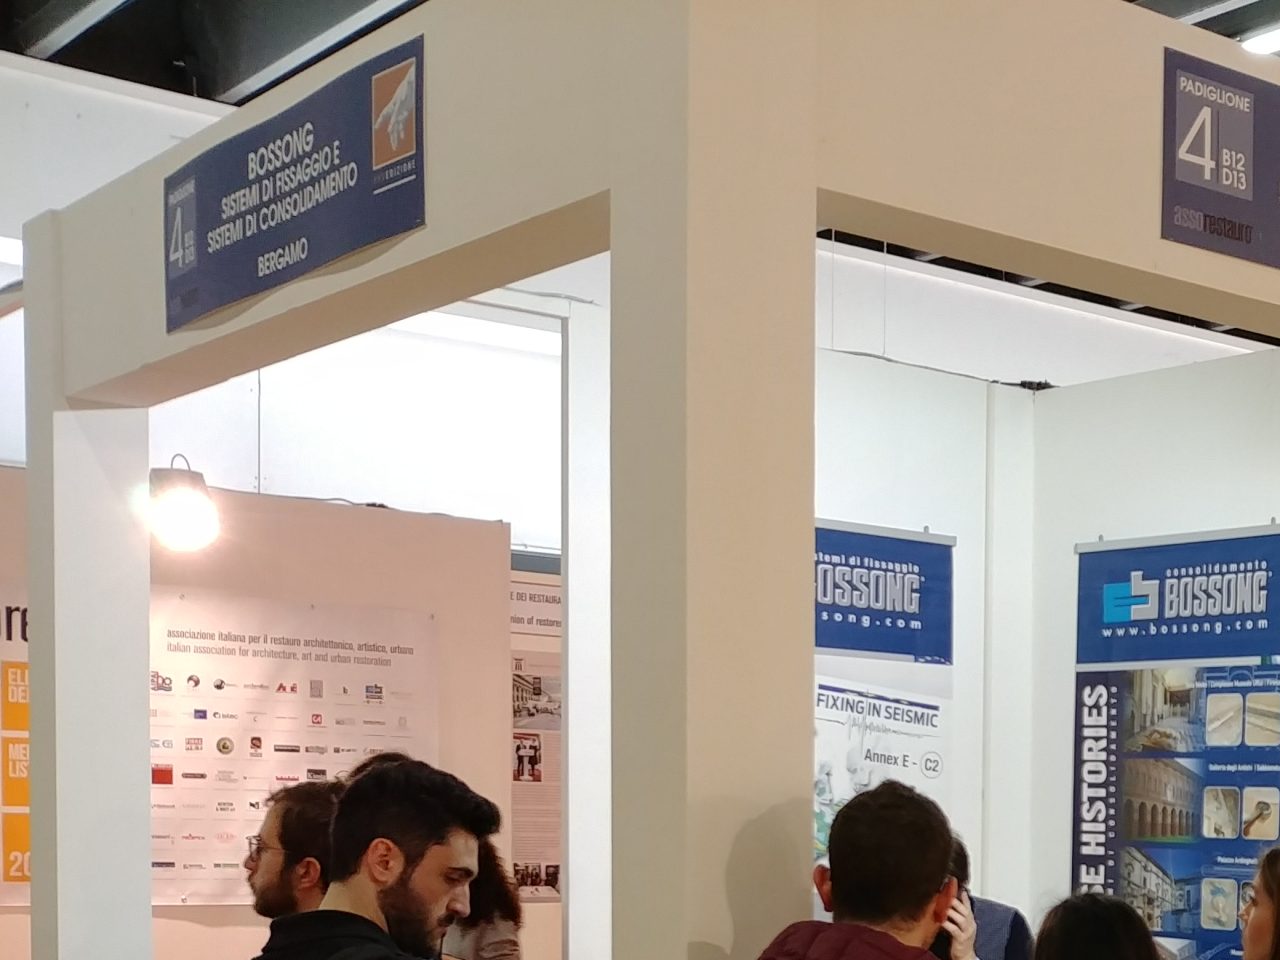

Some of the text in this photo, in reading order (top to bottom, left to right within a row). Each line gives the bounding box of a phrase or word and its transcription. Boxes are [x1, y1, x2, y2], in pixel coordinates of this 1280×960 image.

[1179, 76, 1251, 113] PADIGLIONE
[248, 121, 315, 181] BOSSONG
[1178, 105, 1216, 181] 4
[1221, 148, 1246, 171] B12
[221, 187, 259, 220] SISTEMI
[261, 181, 274, 202] DI
[275, 146, 332, 196] FISSAGGIO
[332, 139, 341, 165] E
[1222, 167, 1247, 191] D13
[207, 219, 244, 253] SISTEMI
[245, 214, 257, 235] DI
[259, 161, 358, 231] CONSOLIDAMENTO
[1174, 204, 1254, 245] assorestauro
[169, 206, 184, 268] 4
[257, 237, 309, 278] BERGAMO
[848, 555, 861, 566] di
[863, 557, 920, 574] fissaggio
[1165, 559, 1268, 578] consolidamento
[516, 591, 527, 602] DEI
[1164, 570, 1269, 619] BOSSONG
[166, 628, 216, 641] associazione
[217, 630, 247, 644] italiana
[247, 633, 261, 646] per
[263, 633, 269, 645] il
[270, 635, 301, 647] restauro
[389, 644, 414, 656] urbano
[1101, 618, 1269, 638] www.bossong.com
[166, 641, 392, 668] italian association for architecture, art and urban restoration
[816, 692, 939, 729] FIXING IN SEISMIC
[863, 748, 900, 767] Annex
[902, 754, 910, 768] E
[924, 757, 940, 773] C2
[1080, 684, 1109, 856] HISTORIES
